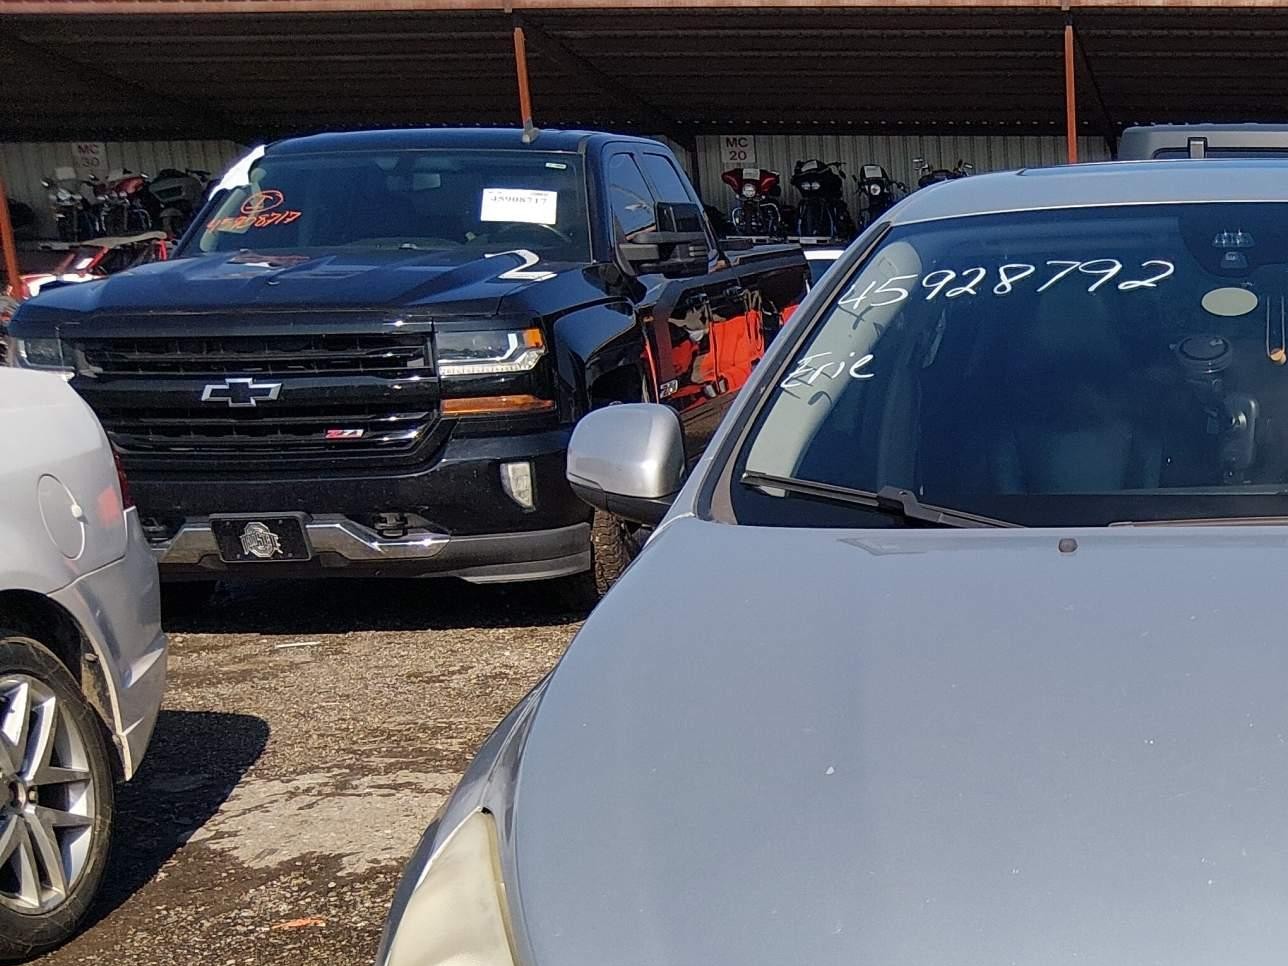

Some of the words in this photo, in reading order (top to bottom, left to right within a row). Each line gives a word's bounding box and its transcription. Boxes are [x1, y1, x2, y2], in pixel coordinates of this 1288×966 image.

[726, 136, 749, 148] MC
[78, 143, 99, 154] MC
[729, 150, 747, 161] 20
[837, 258, 1175, 310] 45928792
